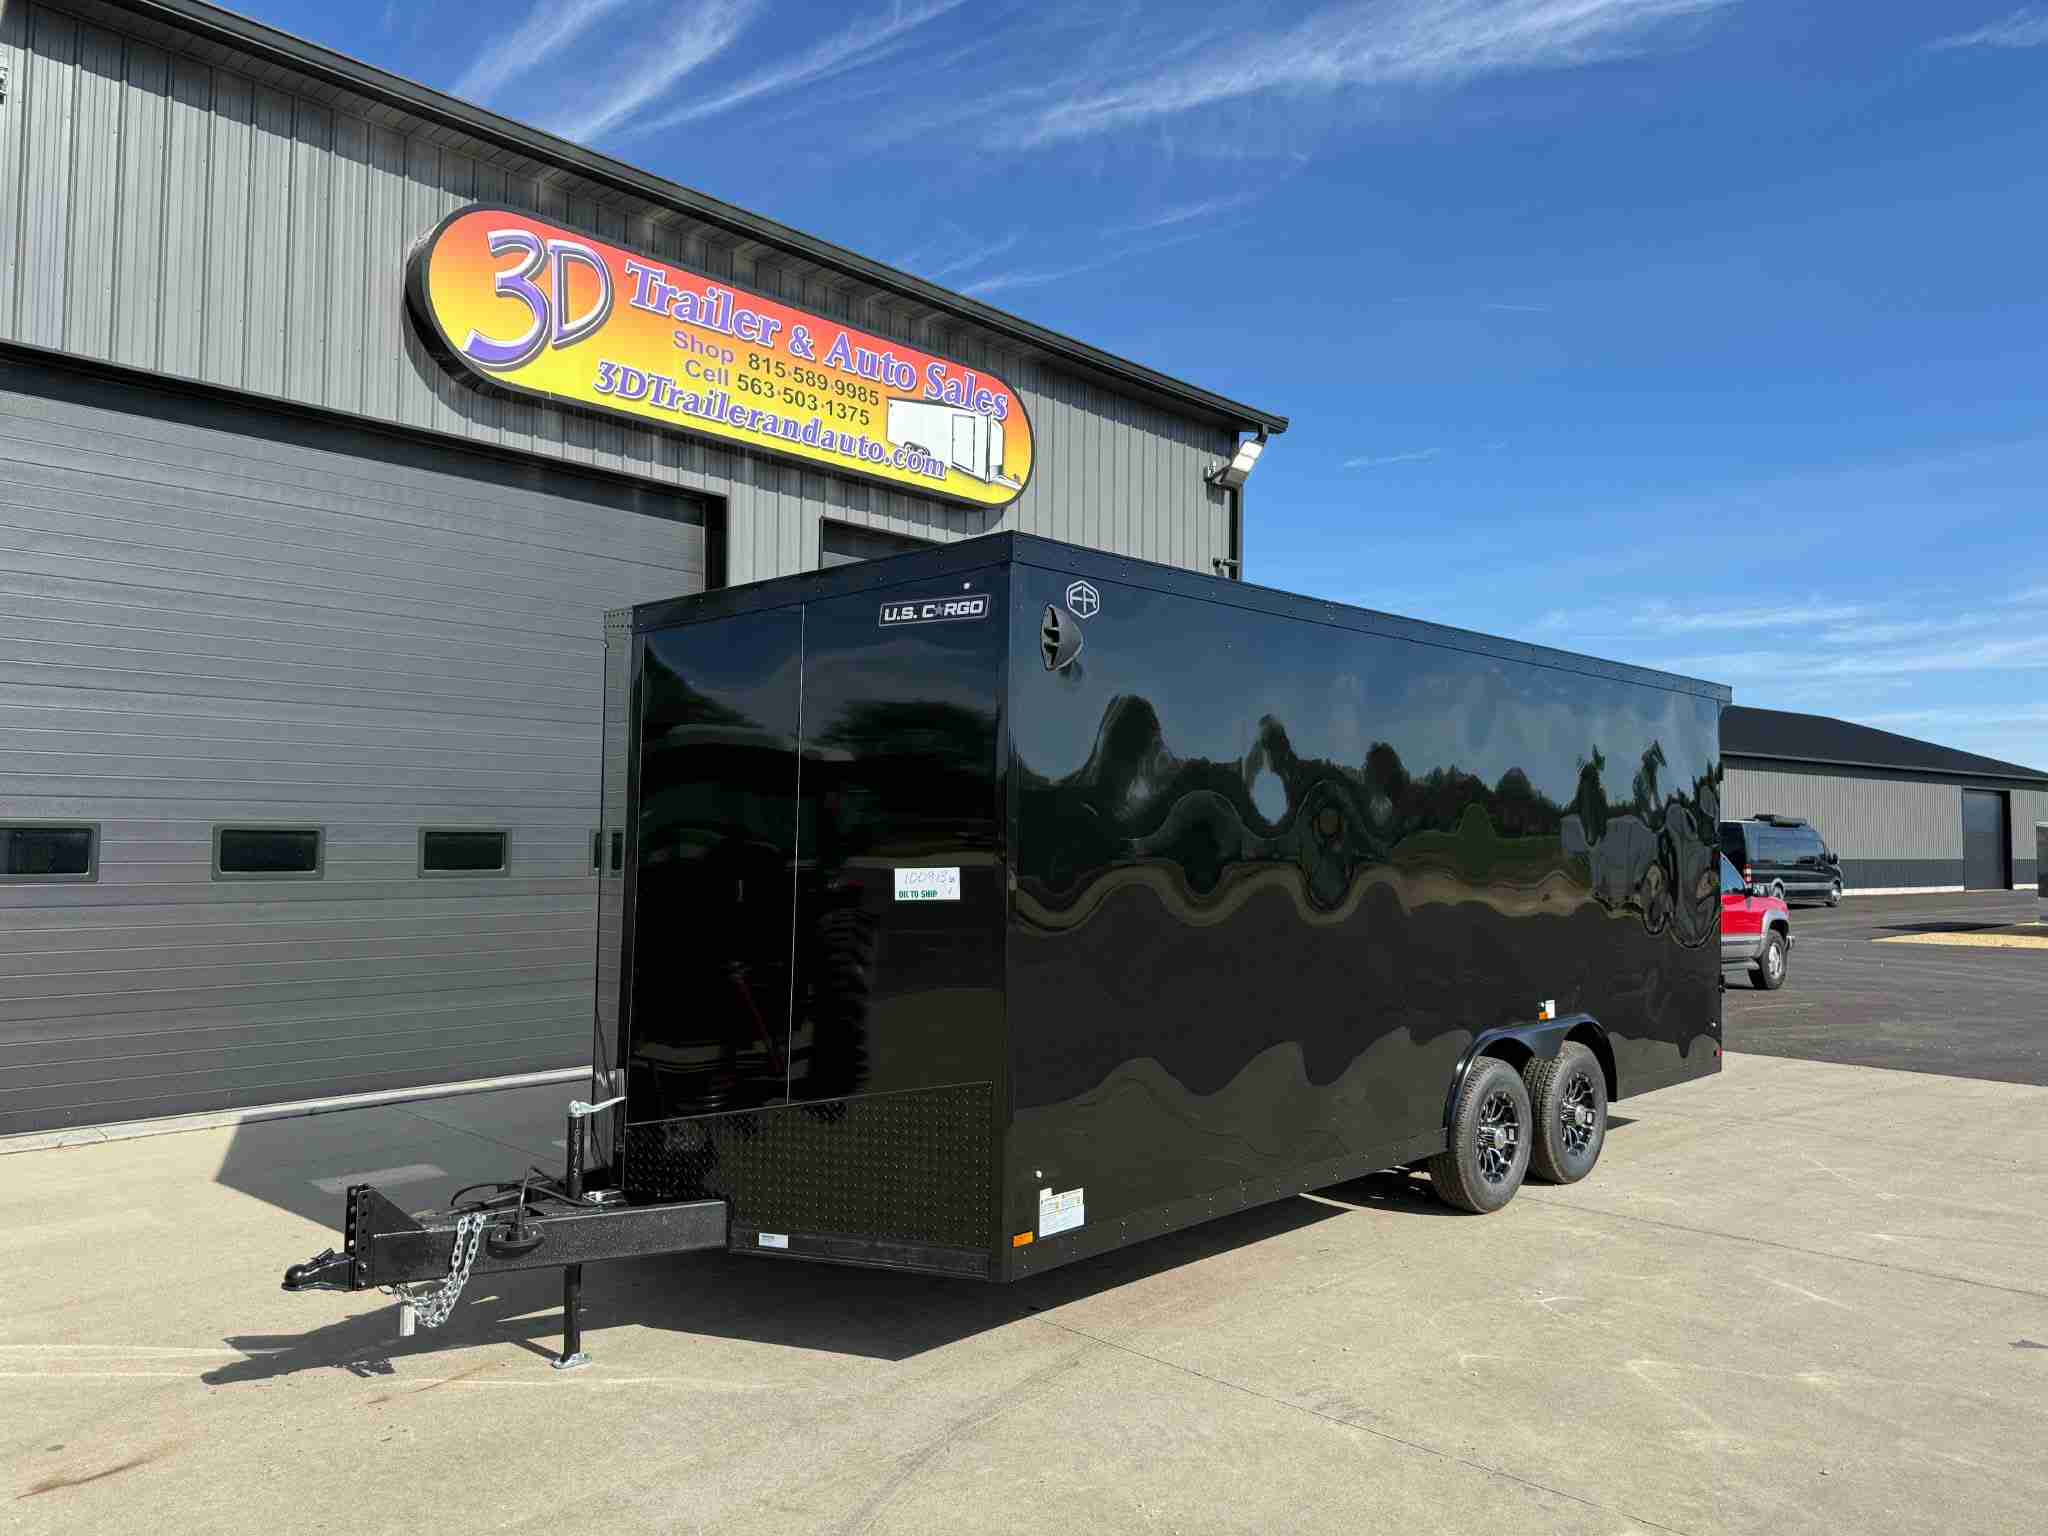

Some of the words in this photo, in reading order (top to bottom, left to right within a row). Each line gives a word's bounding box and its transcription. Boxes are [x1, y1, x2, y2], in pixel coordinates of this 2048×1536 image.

[461, 229, 615, 372] 3D
[625, 260, 781, 349] Trailer
[788, 324, 816, 361] &
[823, 332, 917, 391] Auto
[923, 361, 1009, 421] Sales
[672, 330, 735, 365] Shop
[684, 358, 729, 387] Cell
[592, 359, 947, 481] 3DTrailerandauto.com
[884, 606, 918, 621] U.S.
